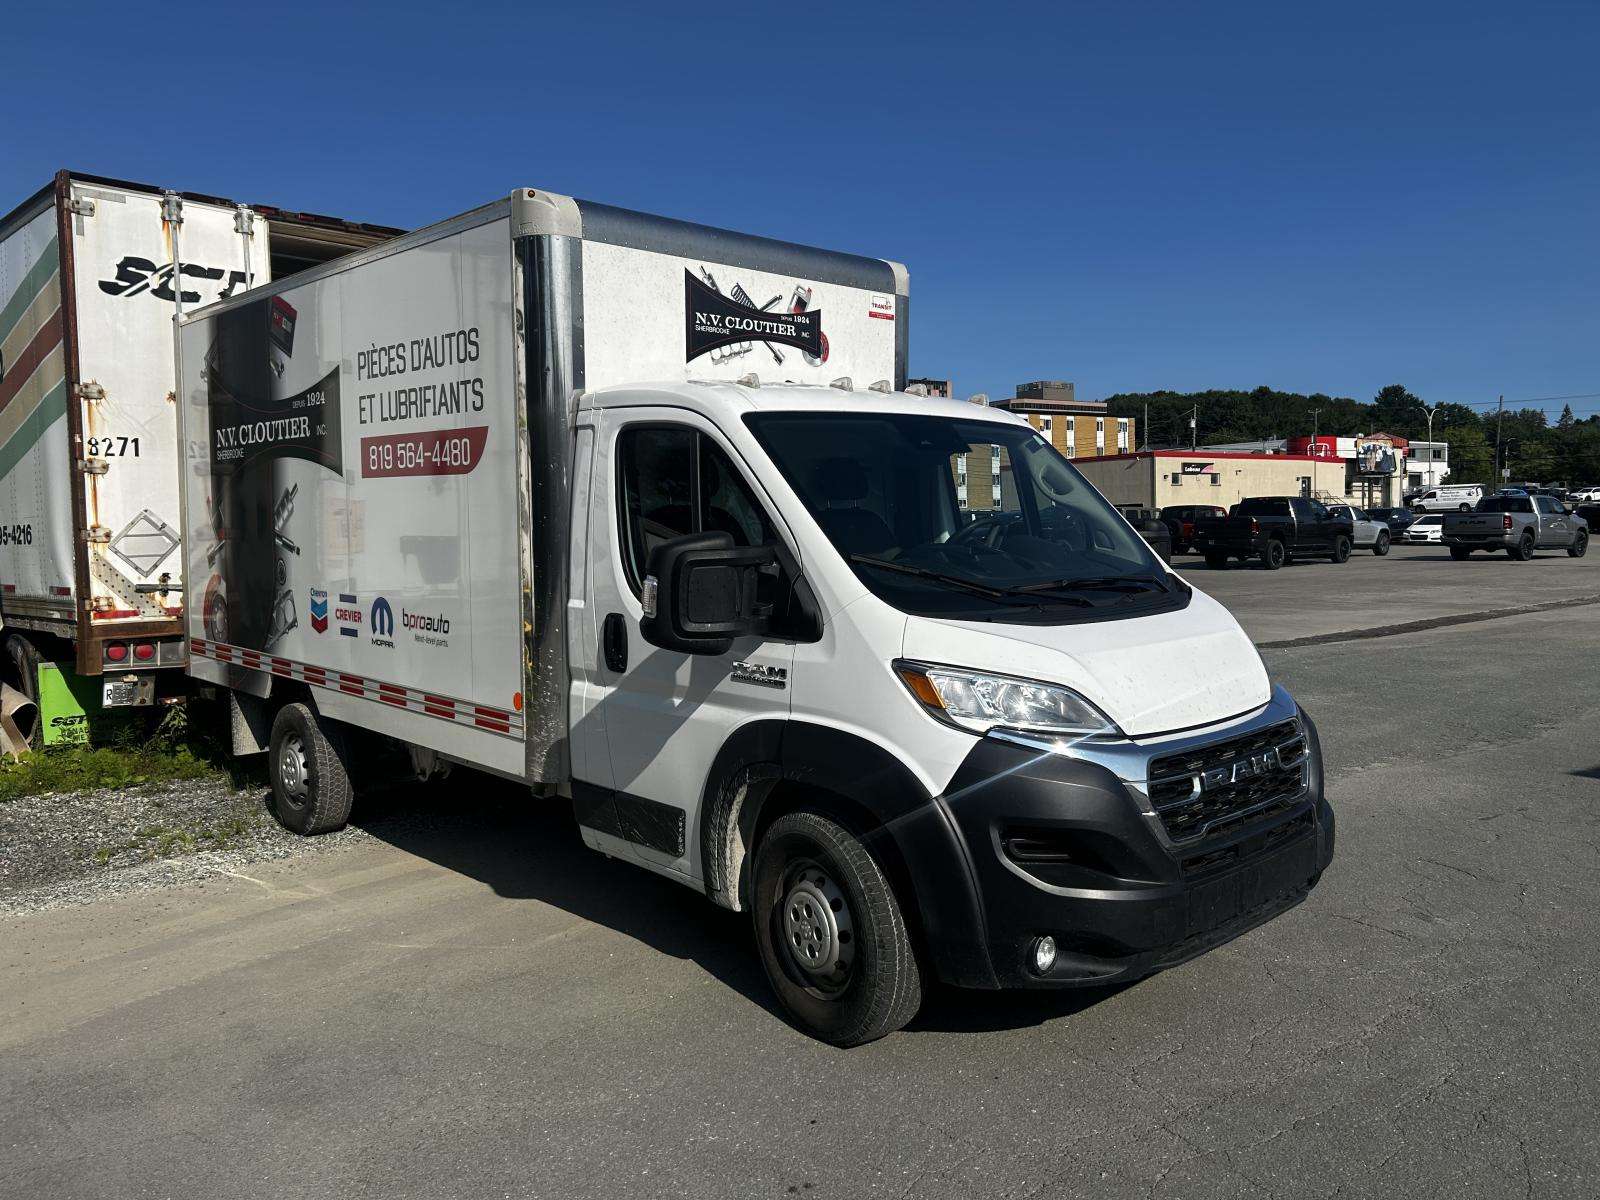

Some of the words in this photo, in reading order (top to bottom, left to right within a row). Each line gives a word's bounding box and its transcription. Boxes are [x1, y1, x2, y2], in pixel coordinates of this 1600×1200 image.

[695, 311, 721, 327] N.V.
[725, 316, 797, 336] CLOUTIER
[793, 315, 810, 324] 1924
[357, 343, 407, 381] PIÈCES
[410, 327, 480, 372] D'AUTOS
[307, 391, 326, 407] 1924
[358, 393, 376, 424] ET
[380, 377, 484, 422] LUBRIFIANTS
[216, 426, 238, 448] N.V.
[239, 416, 311, 445] CLOUTIER
[88, 436, 140, 457] 8271
[369, 444, 393, 470] 819
[397, 438, 471, 468] 564-4480
[0, 524, 32, 546] 5-4216
[335, 608, 363, 624] CREVIER
[402, 607, 450, 634] bproauto
[730, 661, 788, 681] RAM
[1199, 750, 1278, 793] RAM
